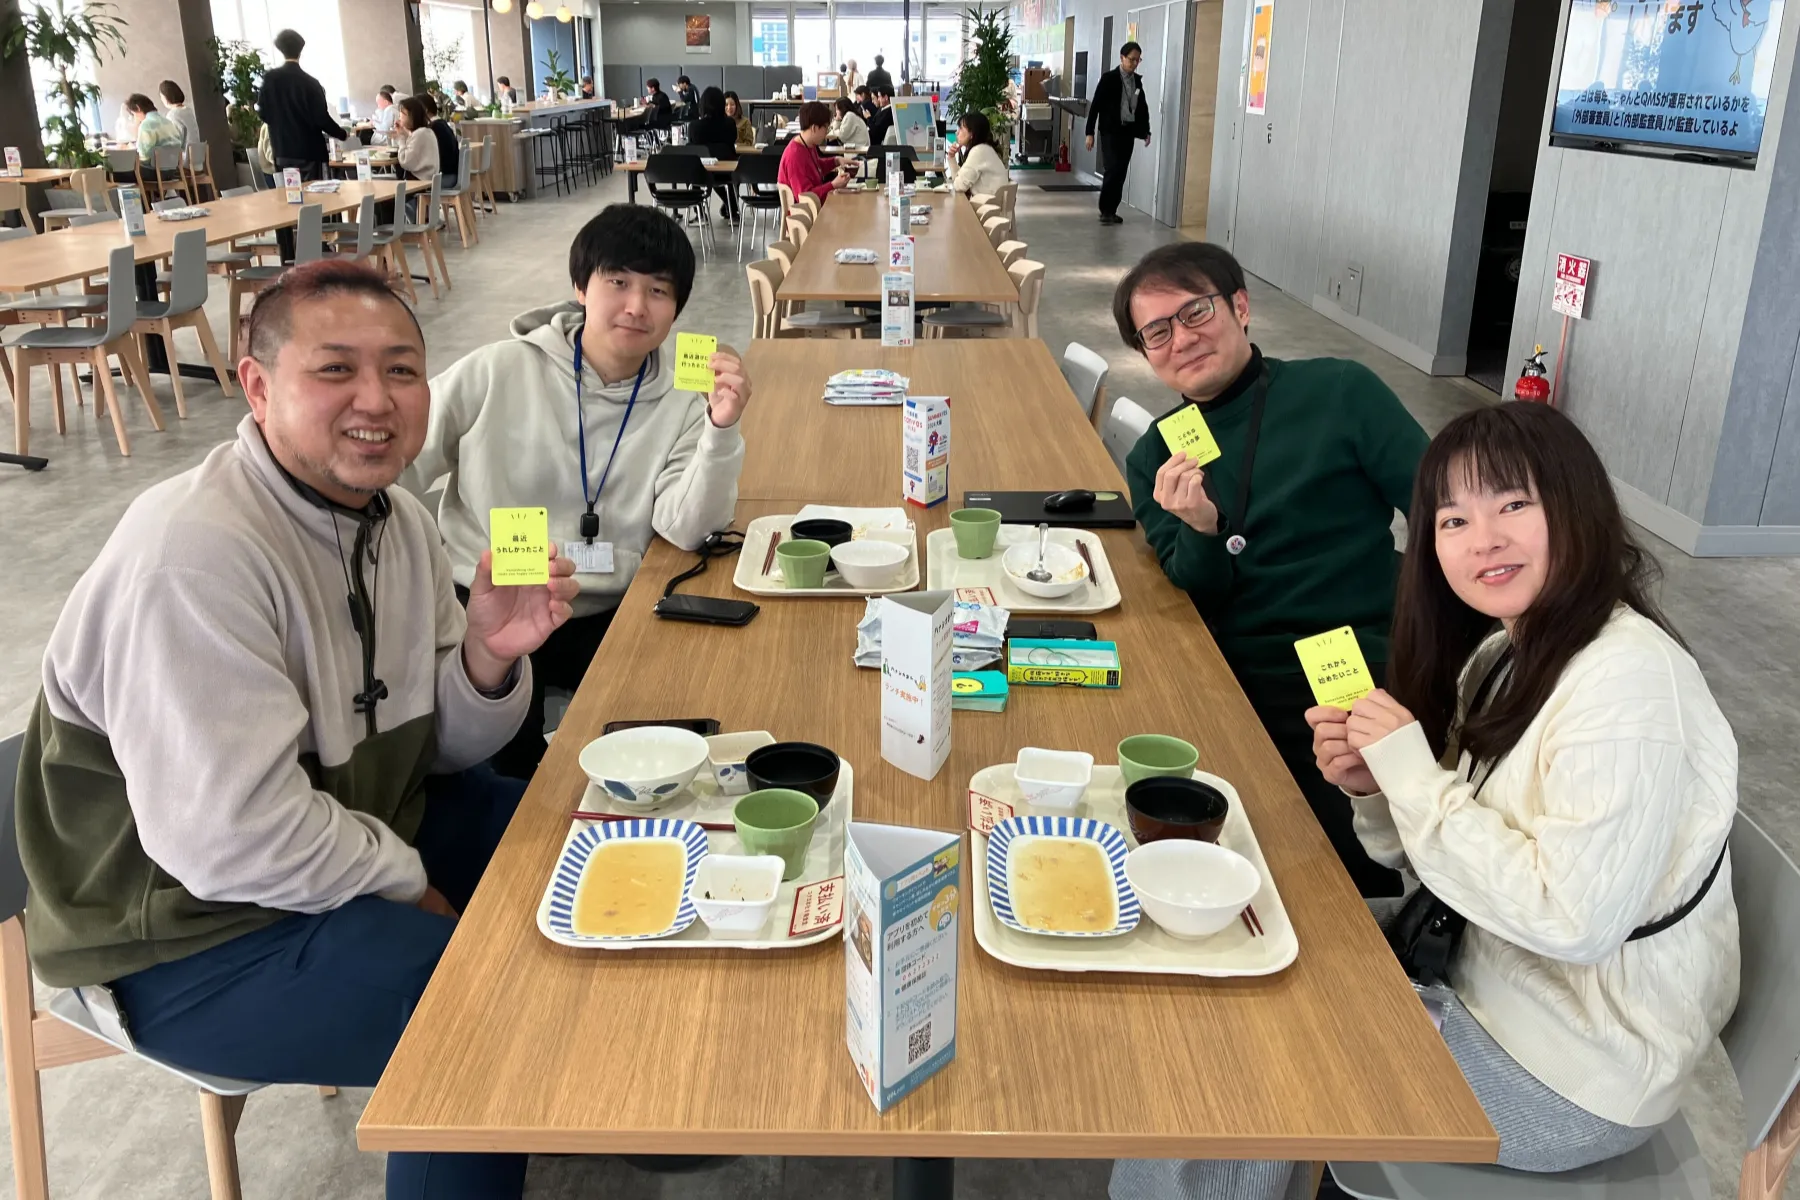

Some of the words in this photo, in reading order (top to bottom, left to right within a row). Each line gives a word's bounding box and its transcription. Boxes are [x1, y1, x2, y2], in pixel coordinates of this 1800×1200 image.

[1558, 255, 1588, 279] 消火器
[512, 534, 527, 542] 最近
[496, 545, 544, 553] うれしかったこと
[1321, 658, 1347, 671] これから
[1317, 668, 1359, 684] 始めたいこと
[813, 882, 836, 925] 支払い済
[887, 910, 929, 940] アプリを初めて
[886, 925, 925, 952] 利用する方へ
